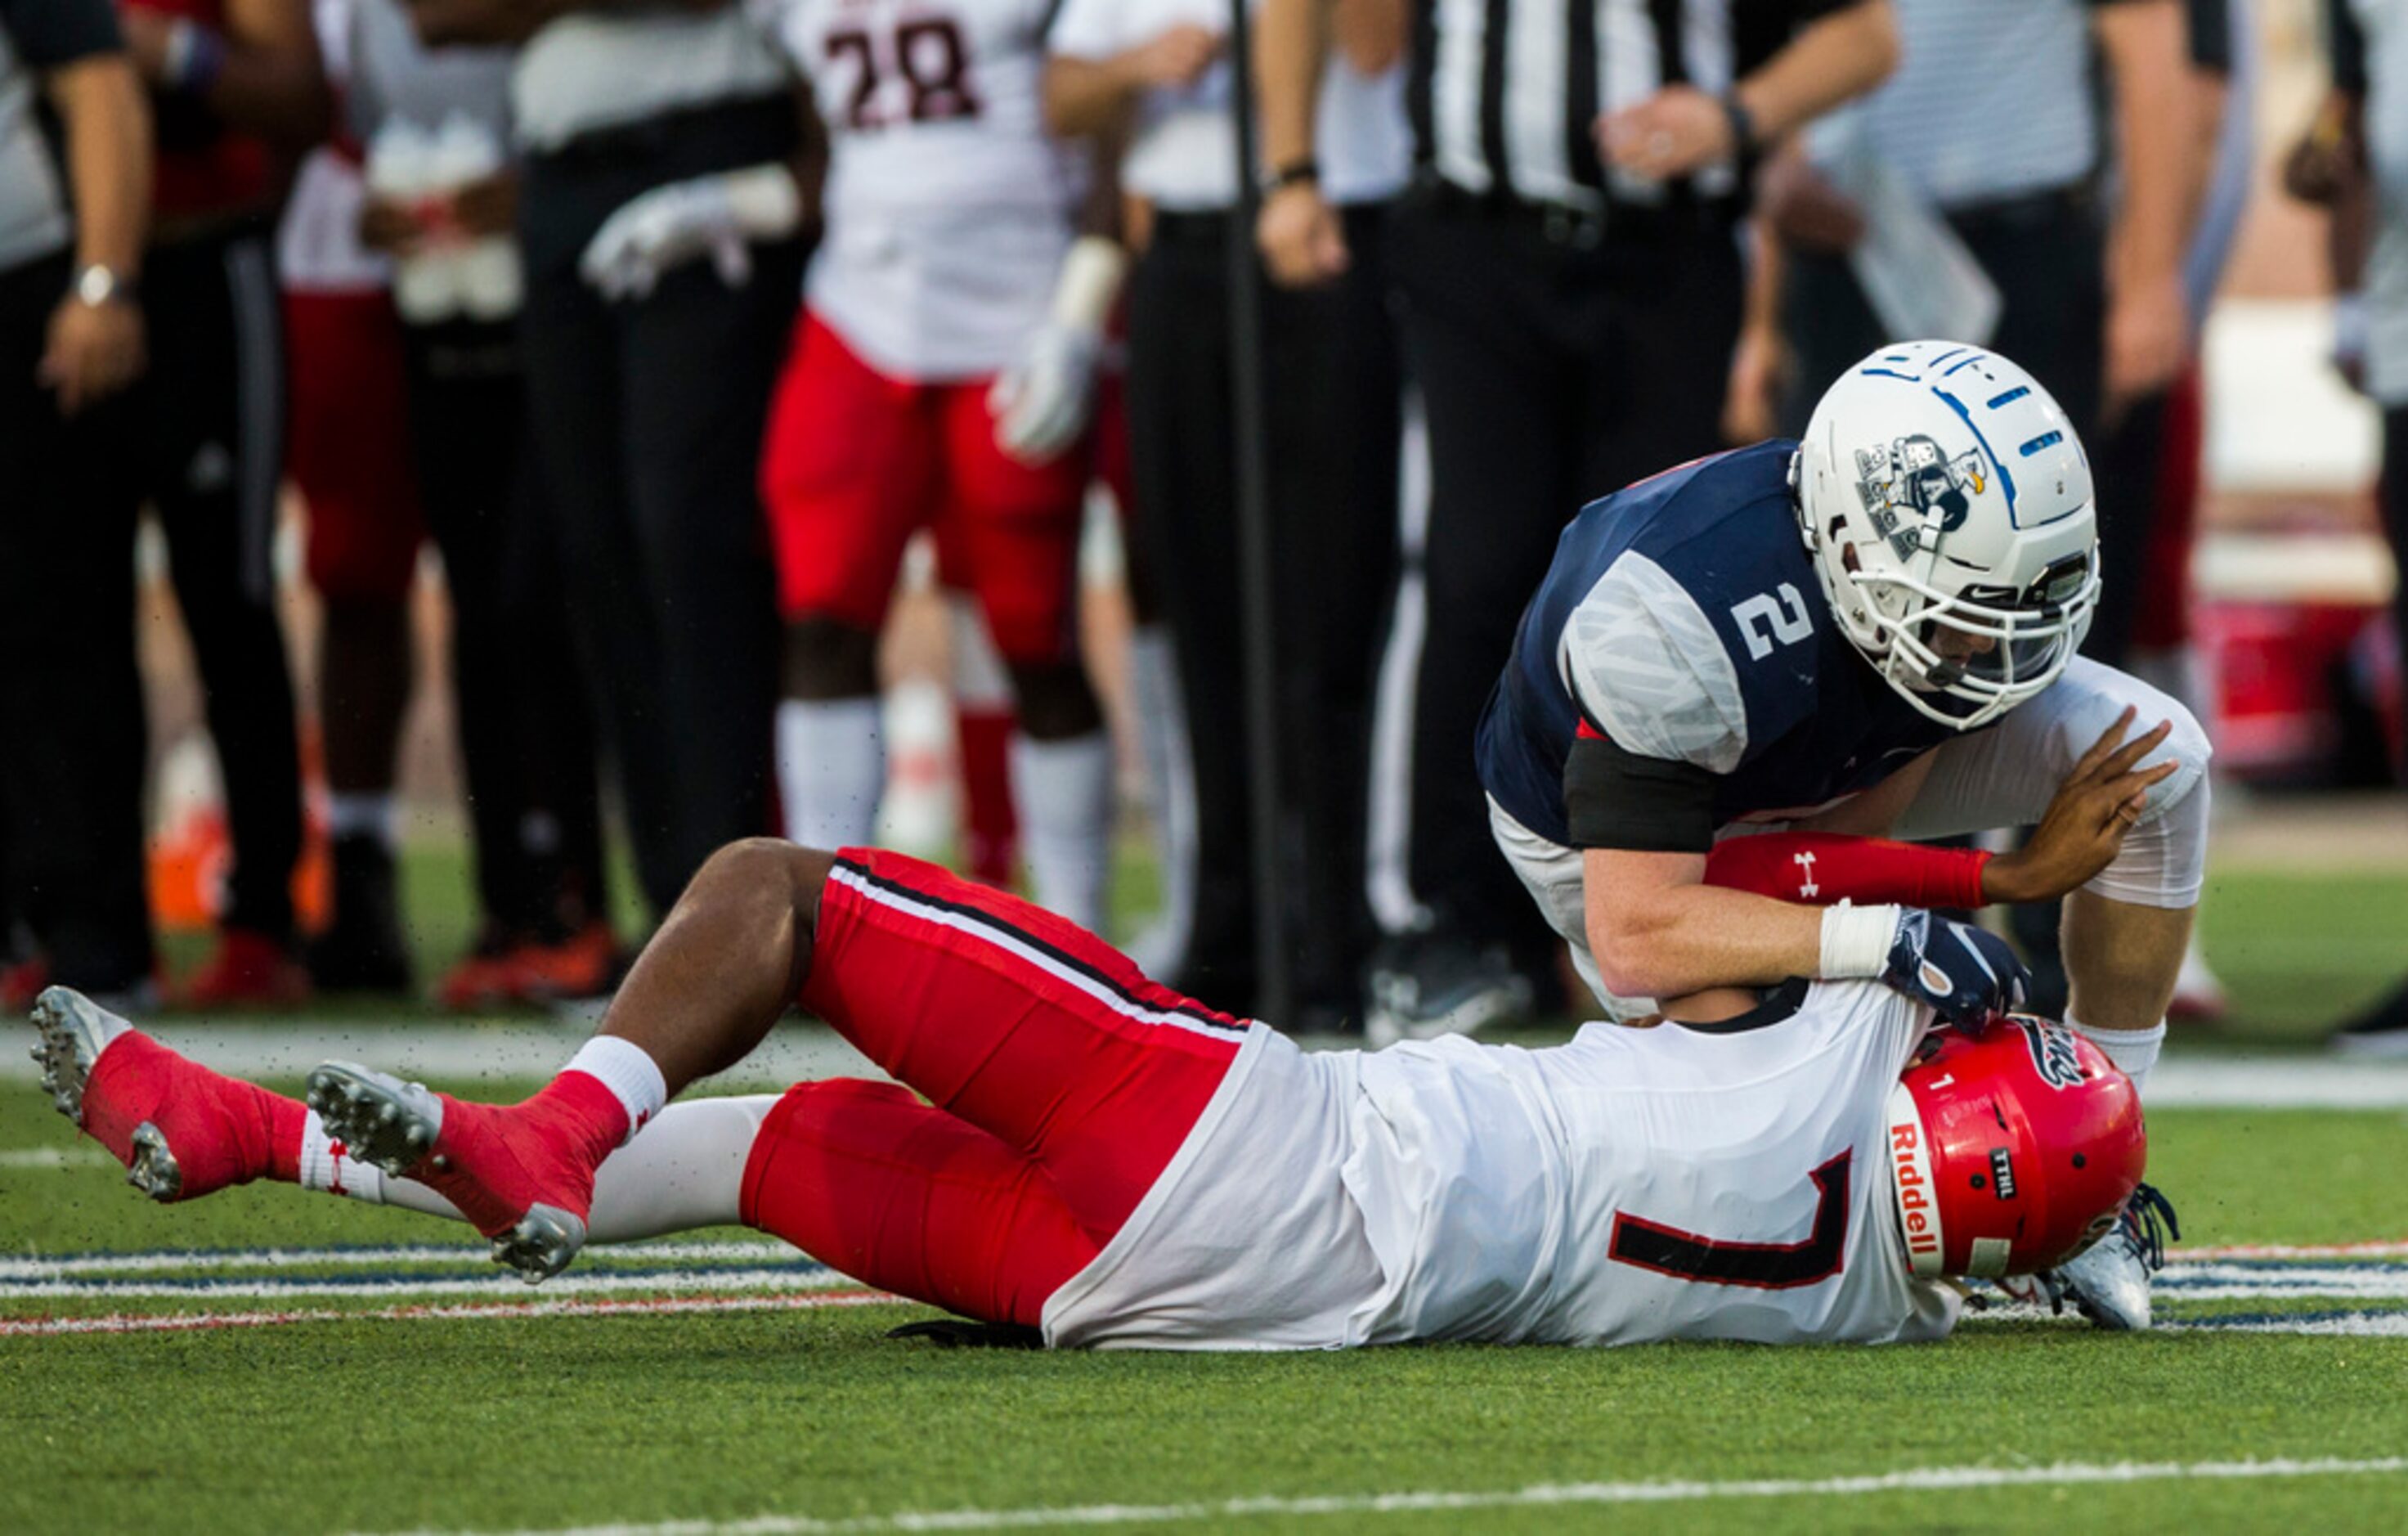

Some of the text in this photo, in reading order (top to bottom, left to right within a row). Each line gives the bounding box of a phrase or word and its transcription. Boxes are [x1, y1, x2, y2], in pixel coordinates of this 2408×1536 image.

[823, 18, 979, 128] 28
[1730, 582, 1814, 661] 2
[1608, 1144, 1853, 1291] 7
[1891, 1122, 1938, 1254] Riddell
